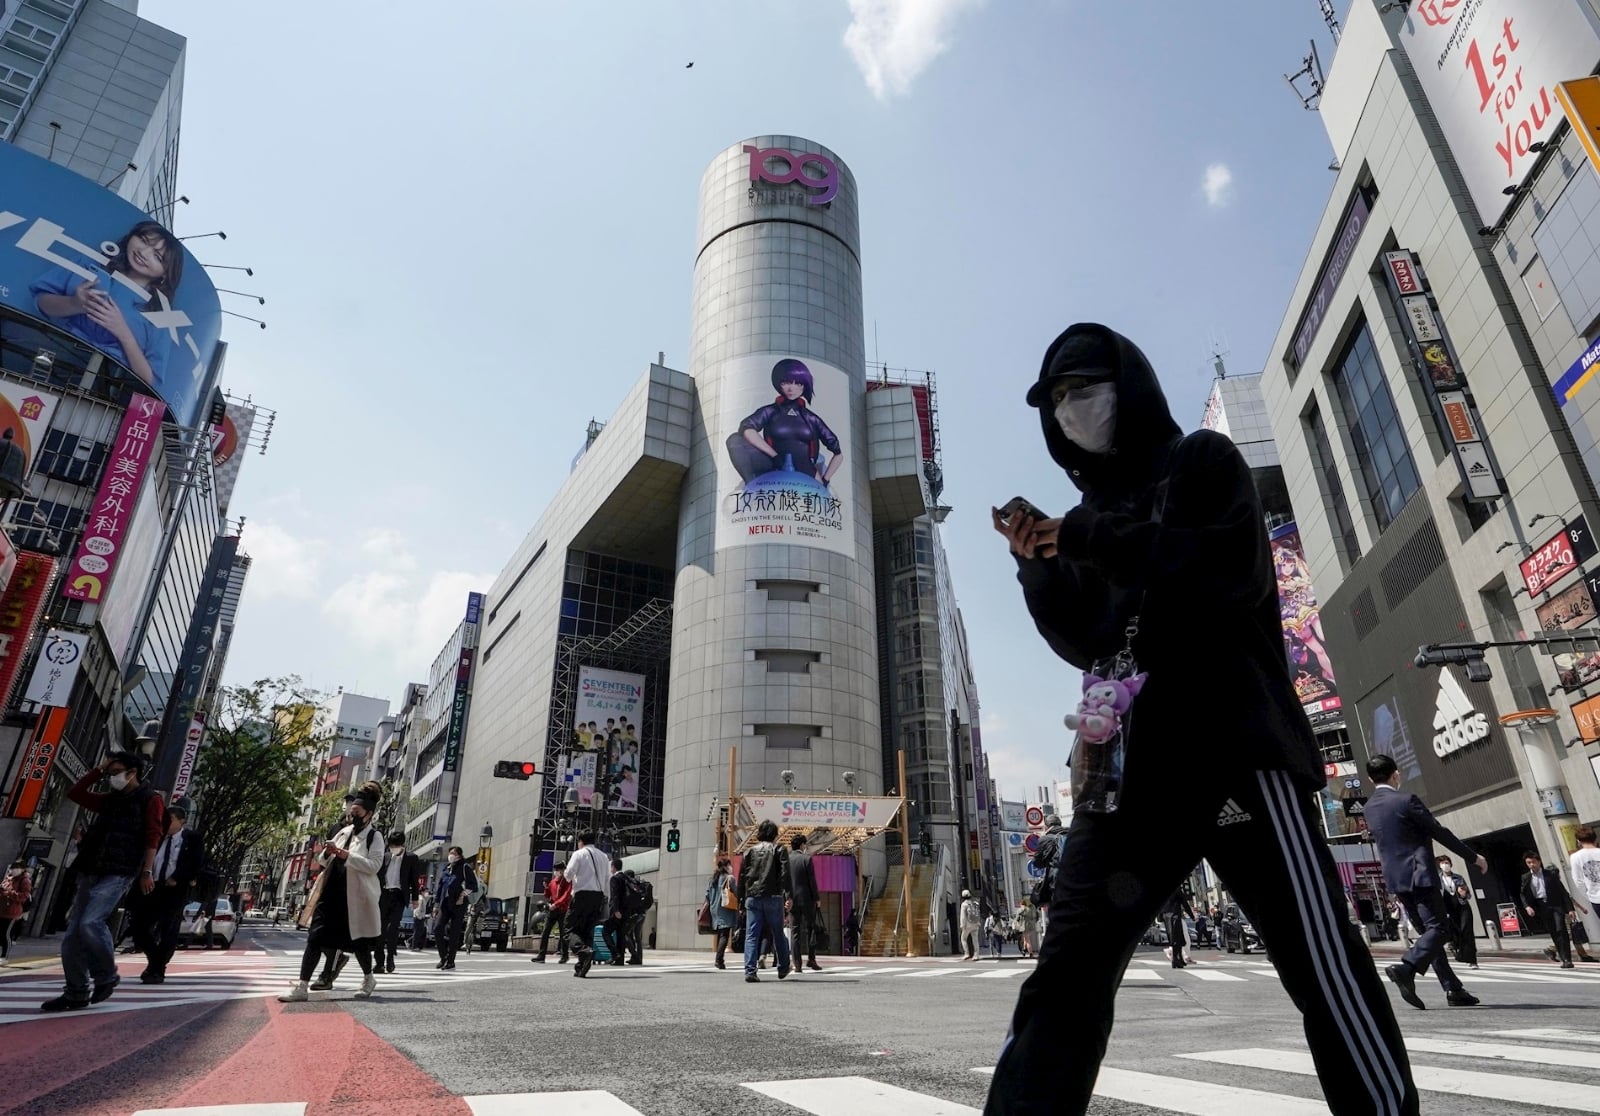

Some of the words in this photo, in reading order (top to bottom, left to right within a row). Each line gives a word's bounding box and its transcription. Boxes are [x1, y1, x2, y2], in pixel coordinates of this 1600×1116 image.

[1465, 17, 1520, 113] 1st
[1495, 65, 1522, 124] for
[743, 145, 839, 205] 109
[1298, 291, 1326, 358] カラオケ
[1581, 344, 1600, 370] Mat
[93, 420, 149, 537] 品川美容外科
[730, 489, 842, 521] 攻殻機動隊
[748, 524, 784, 535] NETFLIX
[1528, 540, 1561, 573] カラオケ
[1527, 568, 1546, 590] BIG
[582, 678, 641, 698] SEVENTEEN
[1432, 712, 1491, 759] adidas
[175, 742, 197, 792] RAKUEN
[782, 800, 867, 817] SEVENTEEN
[1030, 812, 1040, 821] 30
[1217, 812, 1251, 826] adidas
